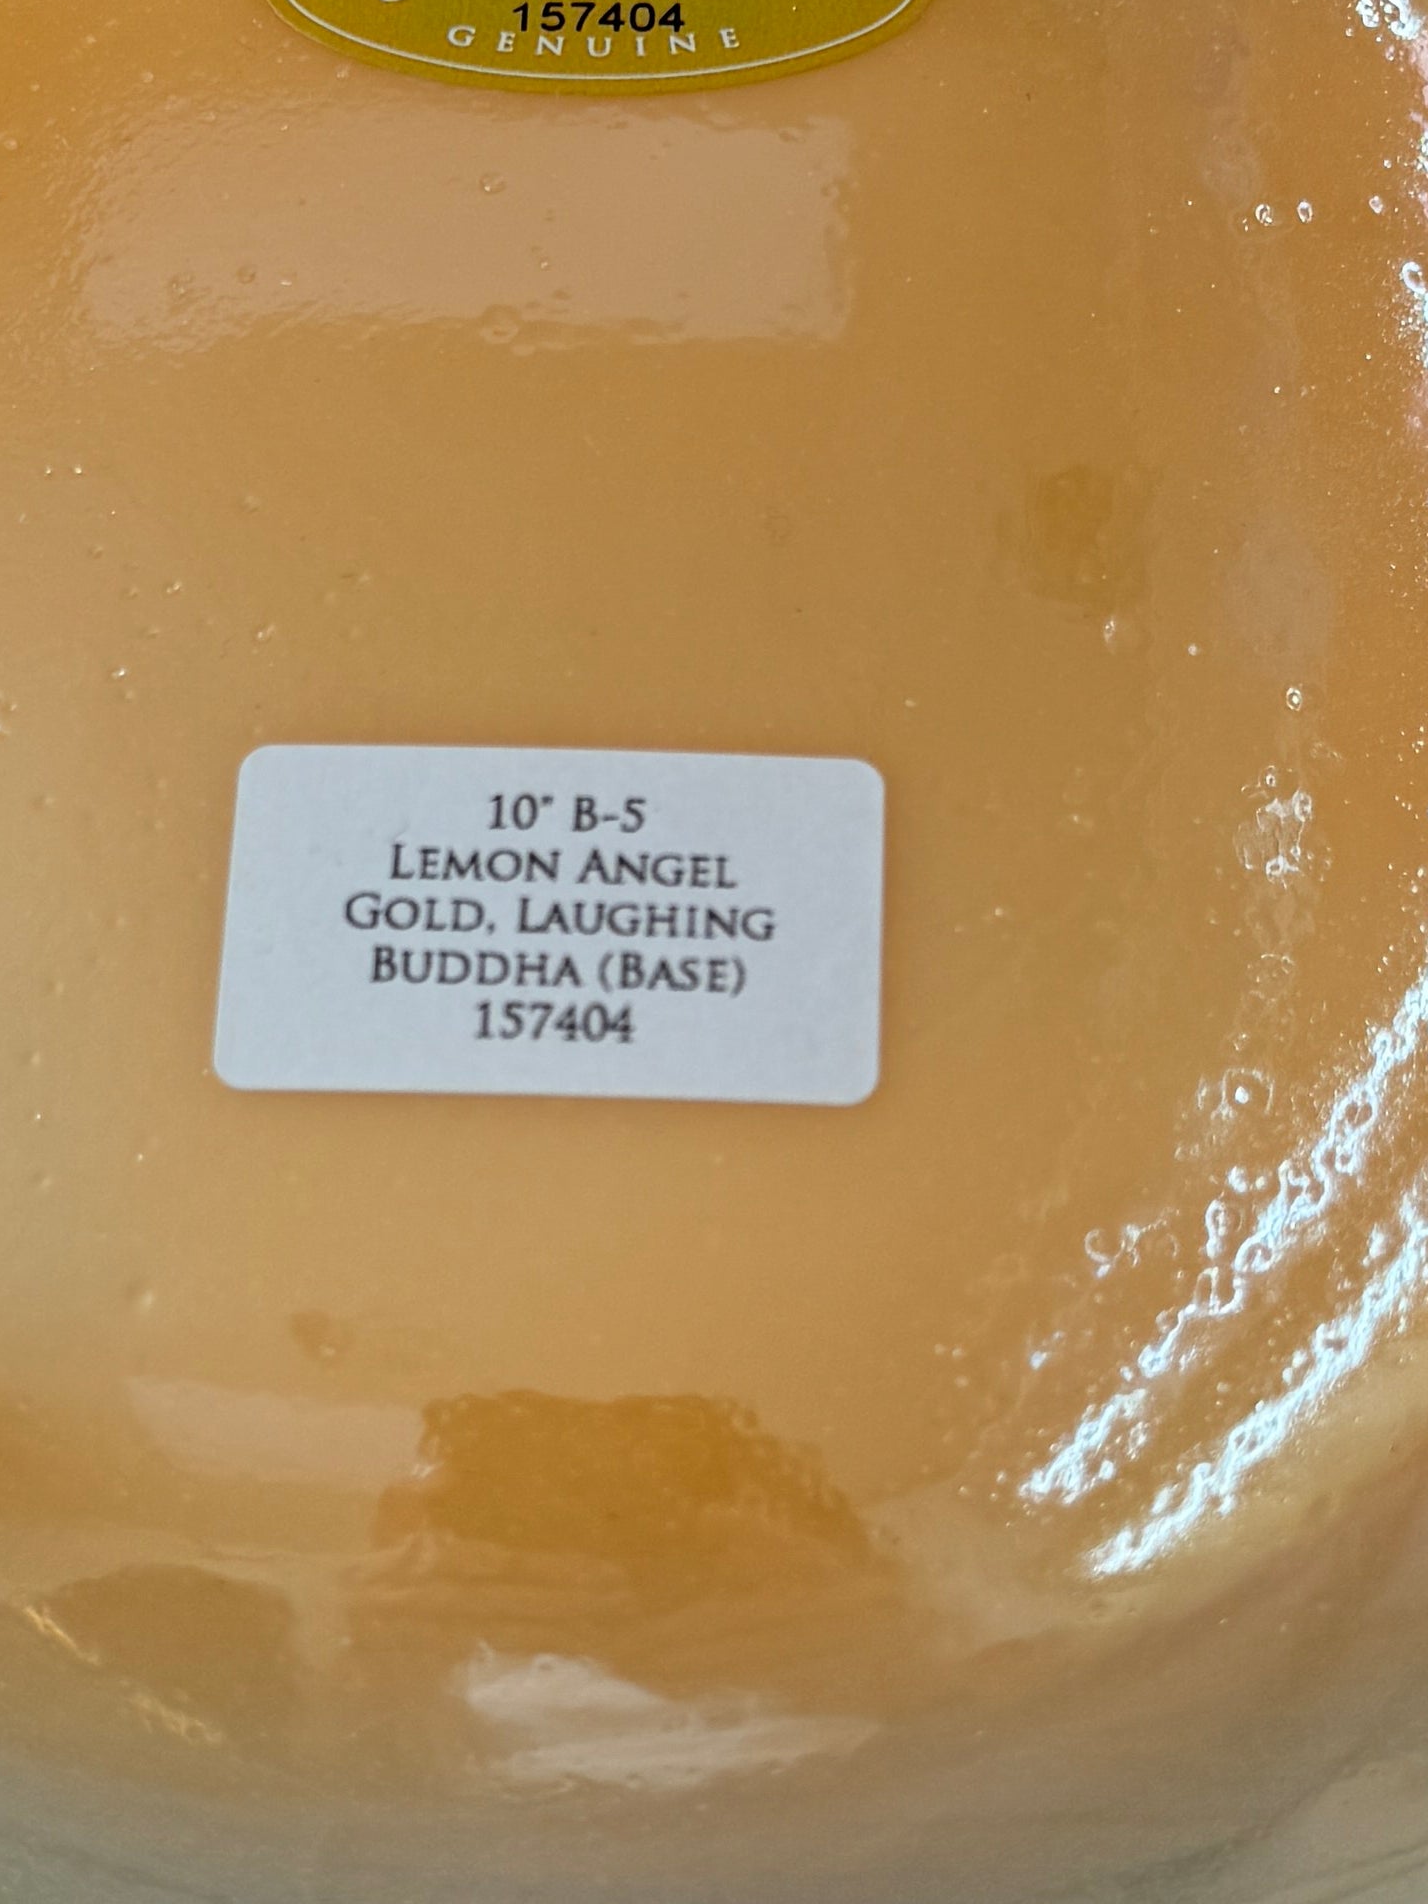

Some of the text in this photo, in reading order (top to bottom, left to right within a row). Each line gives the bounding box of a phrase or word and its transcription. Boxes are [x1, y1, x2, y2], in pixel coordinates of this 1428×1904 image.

[511, 1, 686, 34] 157404
[448, 26, 741, 59] GENUINE
[487, 793, 647, 834] 10" B-5
[472, 1001, 634, 1043] 157404
